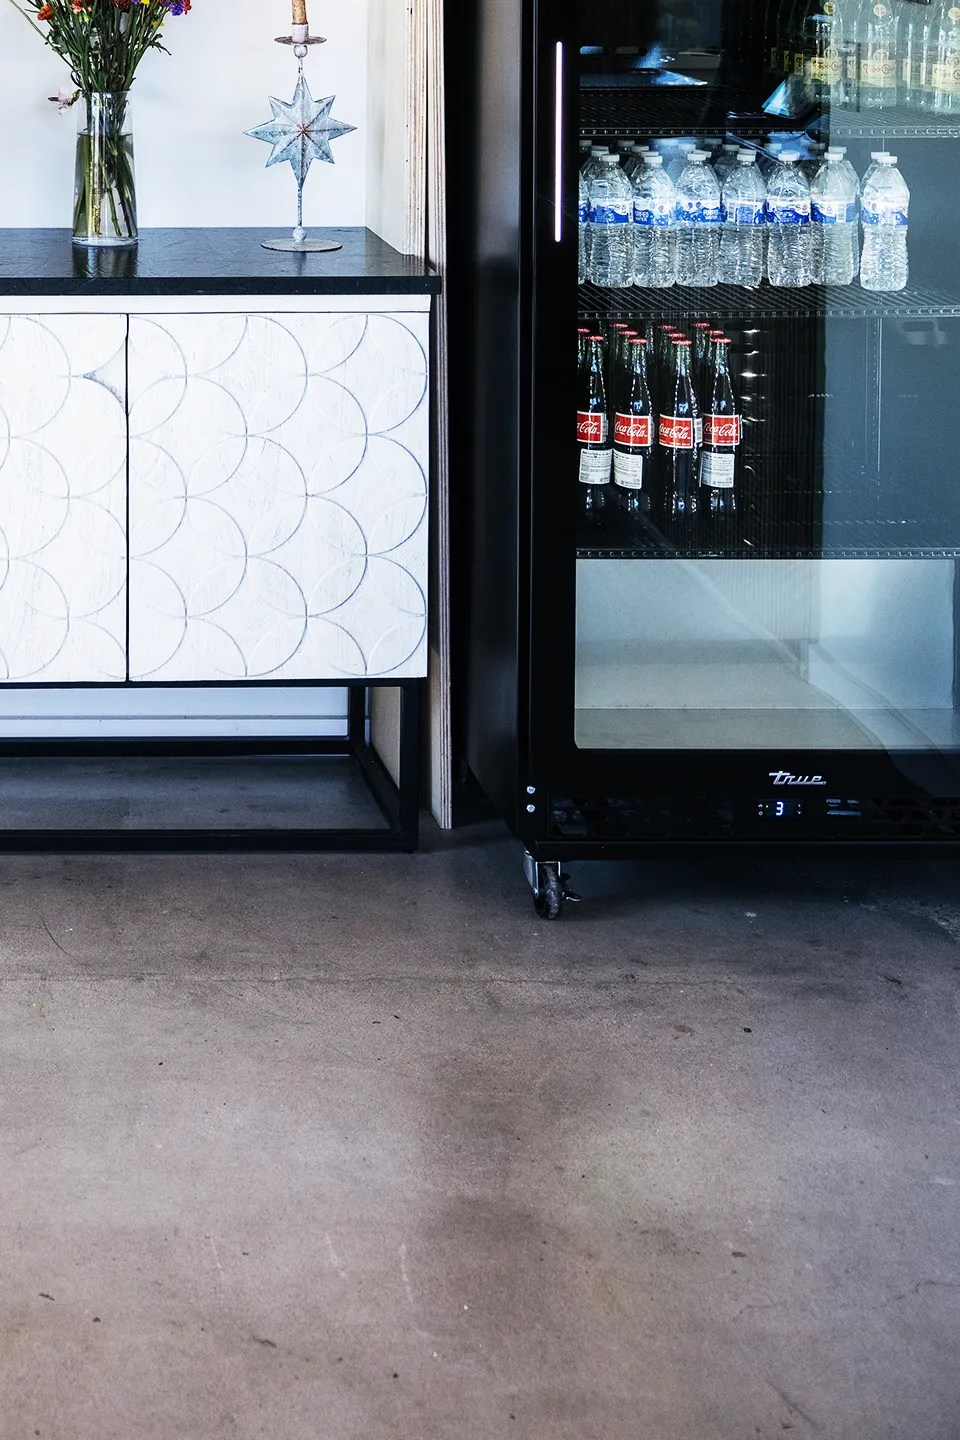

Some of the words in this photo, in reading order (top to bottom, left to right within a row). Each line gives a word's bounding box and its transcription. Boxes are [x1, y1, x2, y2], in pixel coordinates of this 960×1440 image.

[615, 421, 646, 437] Coca-Cola
[659, 423, 689, 439] Coca-Cola
[776, 801, 783, 816] 3
